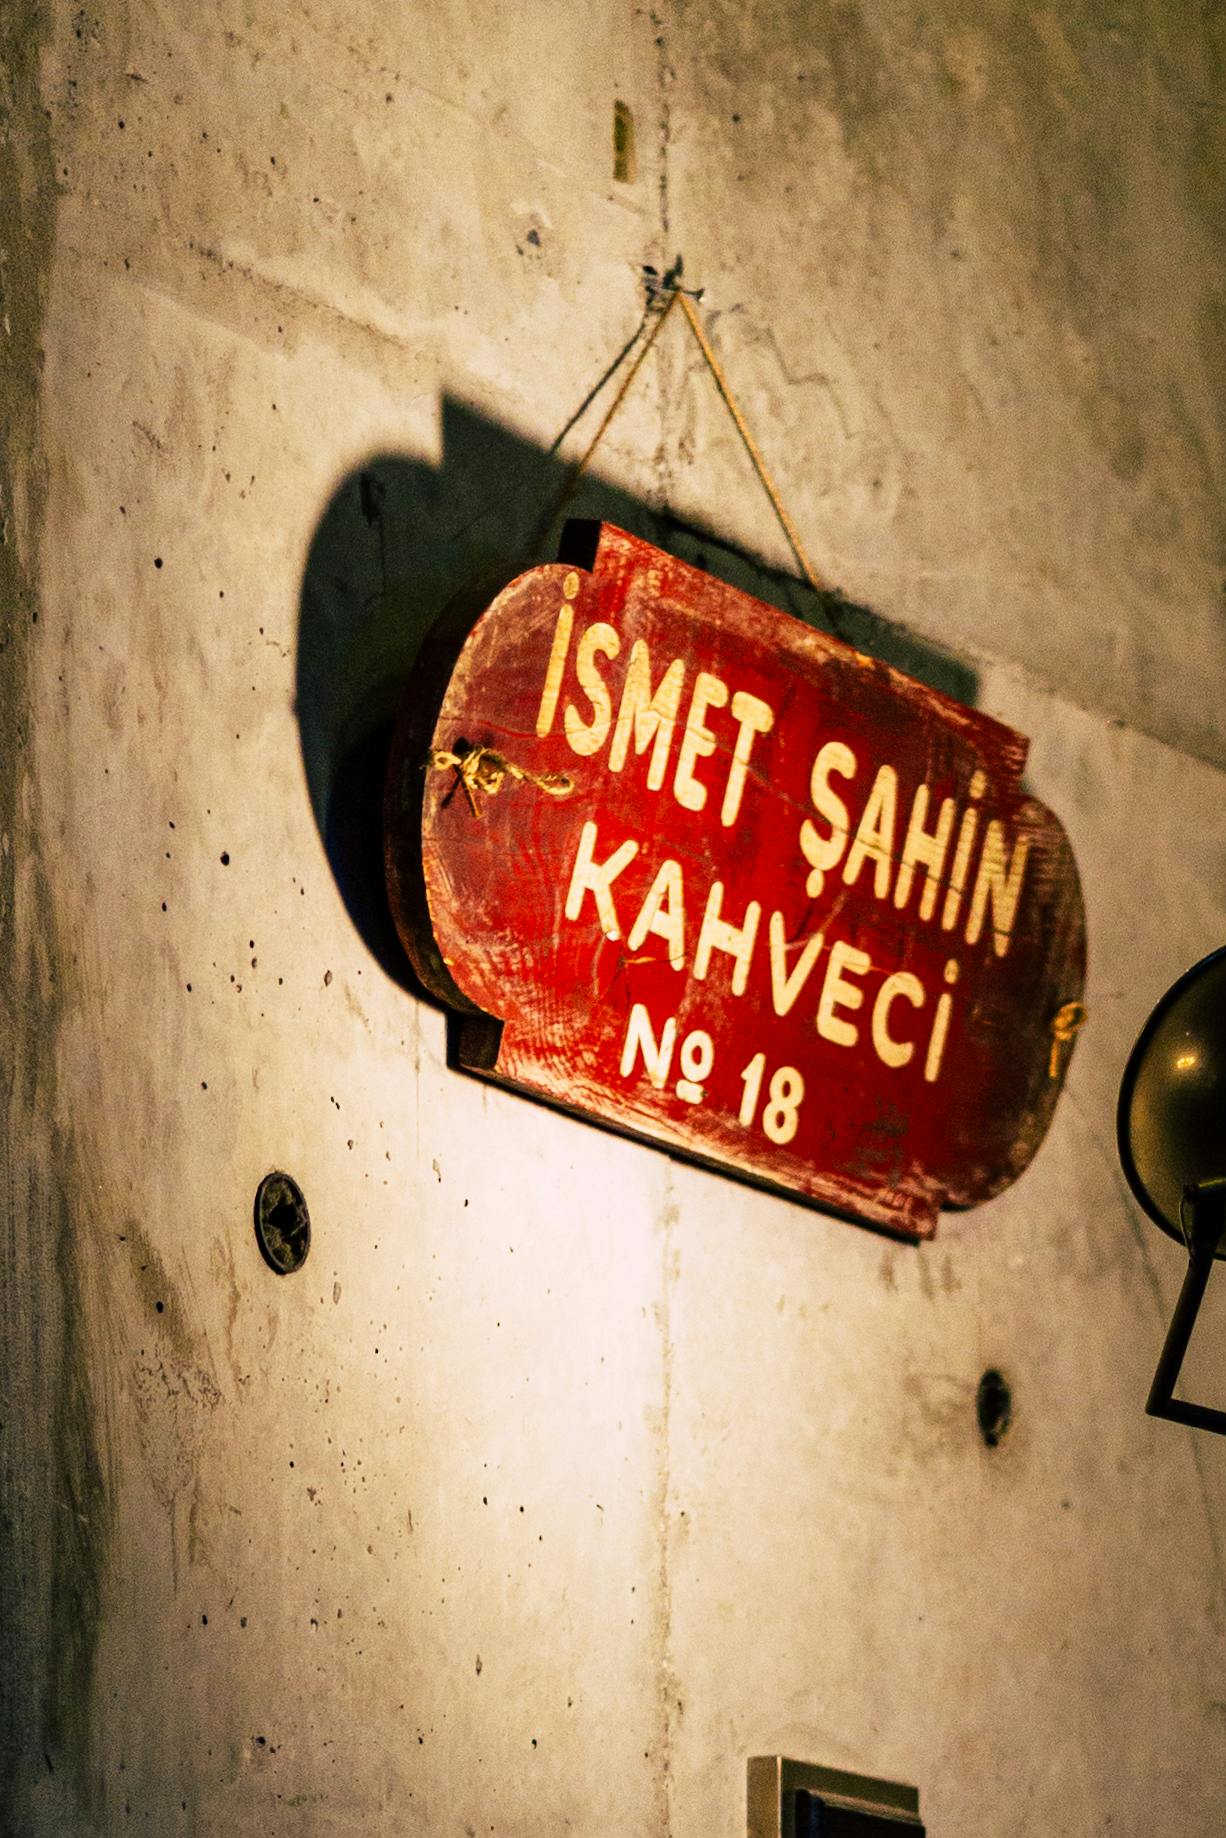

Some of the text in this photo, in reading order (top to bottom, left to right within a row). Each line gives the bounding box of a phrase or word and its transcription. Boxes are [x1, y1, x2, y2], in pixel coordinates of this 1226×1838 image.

[536, 571, 1028, 957] İSMET ŞAHİN
[564, 820, 957, 1082] KAHVECİ
[738, 1052, 805, 1145] 18
